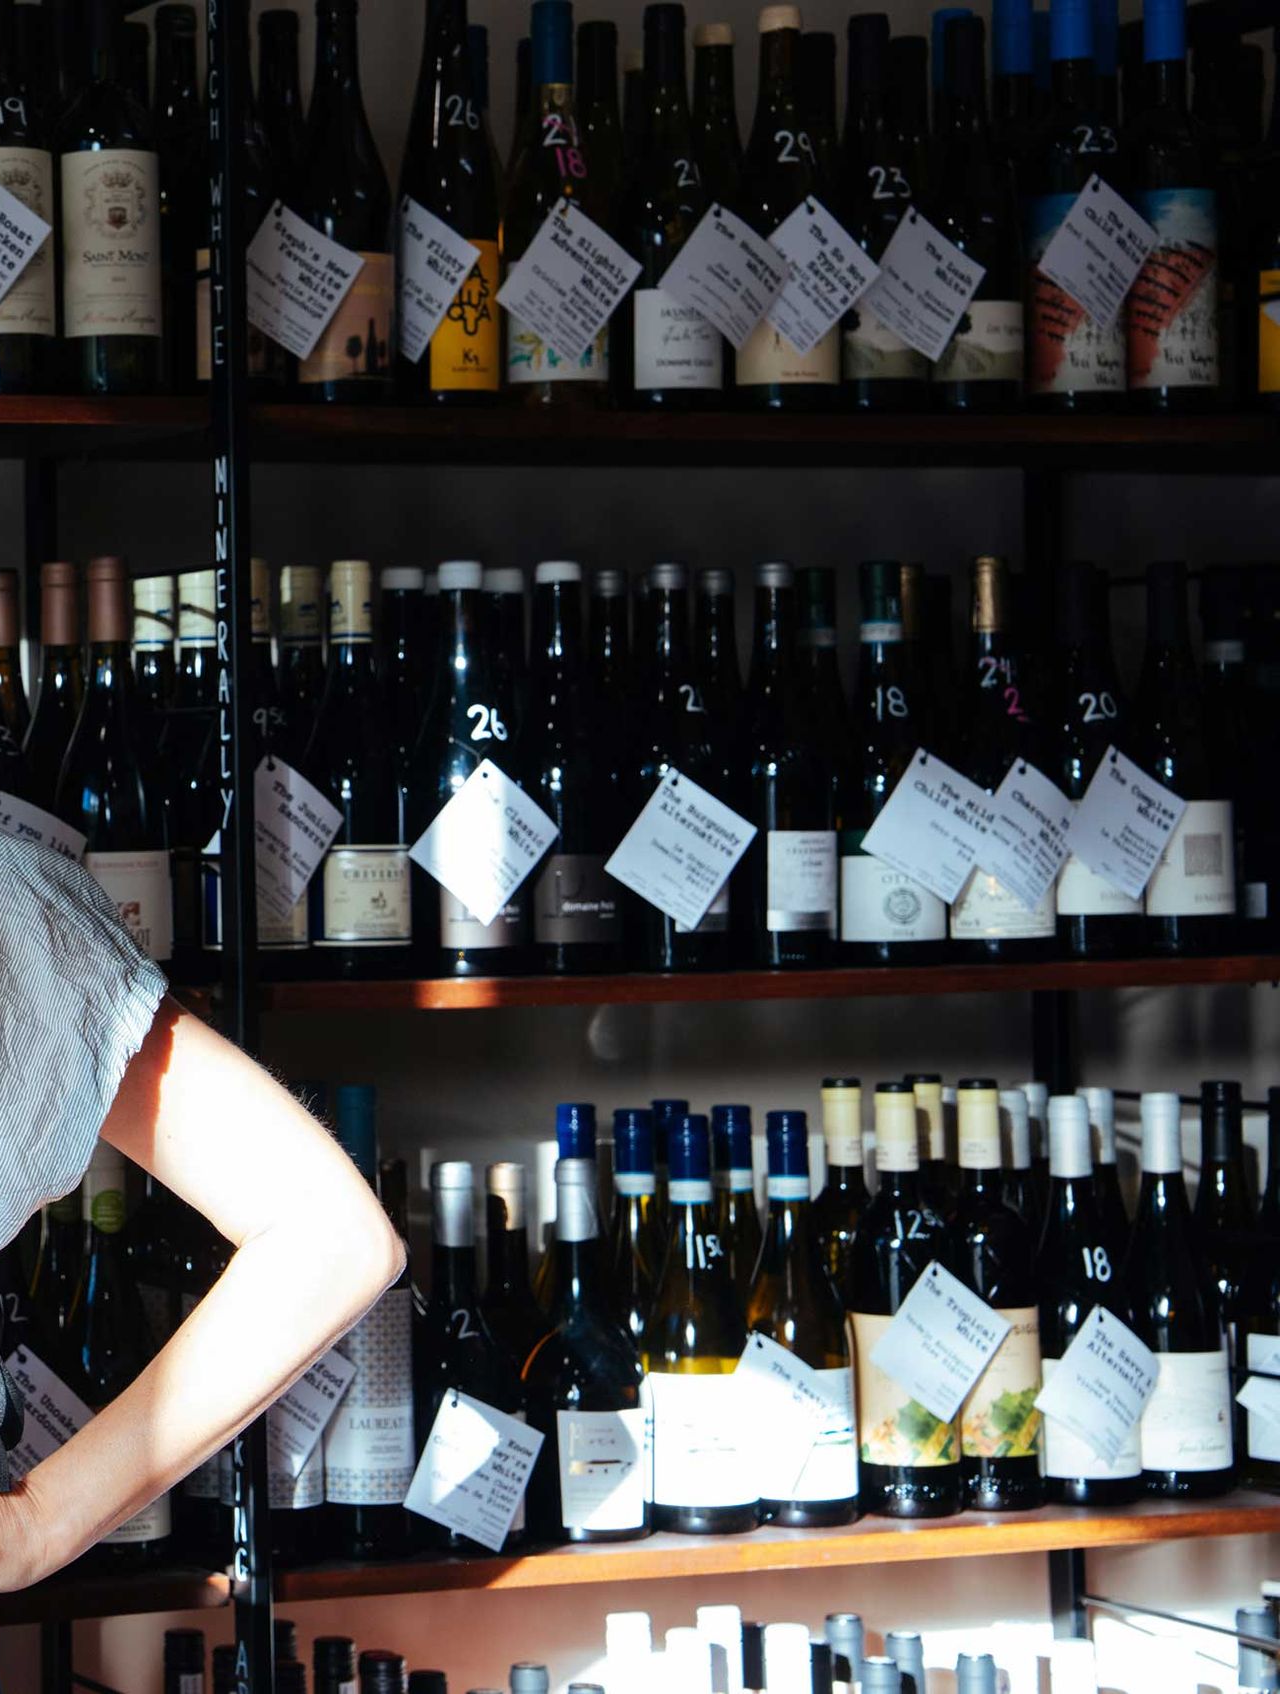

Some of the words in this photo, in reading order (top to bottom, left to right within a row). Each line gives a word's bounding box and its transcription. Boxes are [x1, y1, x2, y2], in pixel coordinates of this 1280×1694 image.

[445, 94, 479, 130] 26
[1074, 125, 1118, 153] 23
[556, 147, 587, 177] 18
[868, 166, 912, 199] 23
[713, 220, 735, 241] The
[809, 223, 829, 246] The
[1082, 205, 1115, 237] Child
[1114, 234, 1143, 265] White
[1105, 210, 1125, 231] The
[404, 222, 424, 241] The
[426, 239, 466, 274] Flinty
[549, 232, 620, 297] Adventurous
[553, 216, 573, 237] The
[577, 237, 629, 285] Slightly
[923, 241, 946, 263] The
[945, 260, 974, 288] Lush
[209, 172, 224, 366] WHITE
[278, 243, 342, 291] Favourite
[326, 260, 350, 280] New
[425, 256, 458, 286] White
[744, 259, 776, 294] White
[804, 259, 841, 296] Savvy
[812, 249, 860, 297] Typical
[933, 265, 968, 297] White
[297, 271, 336, 303] White
[580, 275, 613, 306] White
[214, 456, 234, 830] MINERALLY
[875, 686, 908, 722] 18
[1078, 692, 1118, 723] 20
[466, 704, 508, 741] 26
[938, 782, 963, 802] The
[1109, 767, 1128, 787] The
[270, 779, 295, 802] The
[294, 799, 338, 839] Junior
[660, 786, 683, 805] The
[686, 804, 742, 848] Burgundy
[913, 780, 951, 810] Child
[952, 806, 989, 835] White
[1135, 803, 1171, 832] White
[272, 802, 330, 850] Sancerre
[506, 826, 537, 858] White
[659, 801, 735, 858] Alternative
[1036, 829, 1066, 857] White
[1082, 1246, 1112, 1282] 18
[924, 1278, 943, 1299] The
[946, 1297, 997, 1344] Tropical
[956, 1322, 989, 1355] White
[1093, 1330, 1114, 1350] The
[1118, 1347, 1146, 1379] Savvy
[16, 1370, 37, 1396] The
[771, 1361, 792, 1382] The
[1086, 1341, 1147, 1401] Alternative
[507, 1440, 533, 1458] Know
[490, 1462, 522, 1484] White
